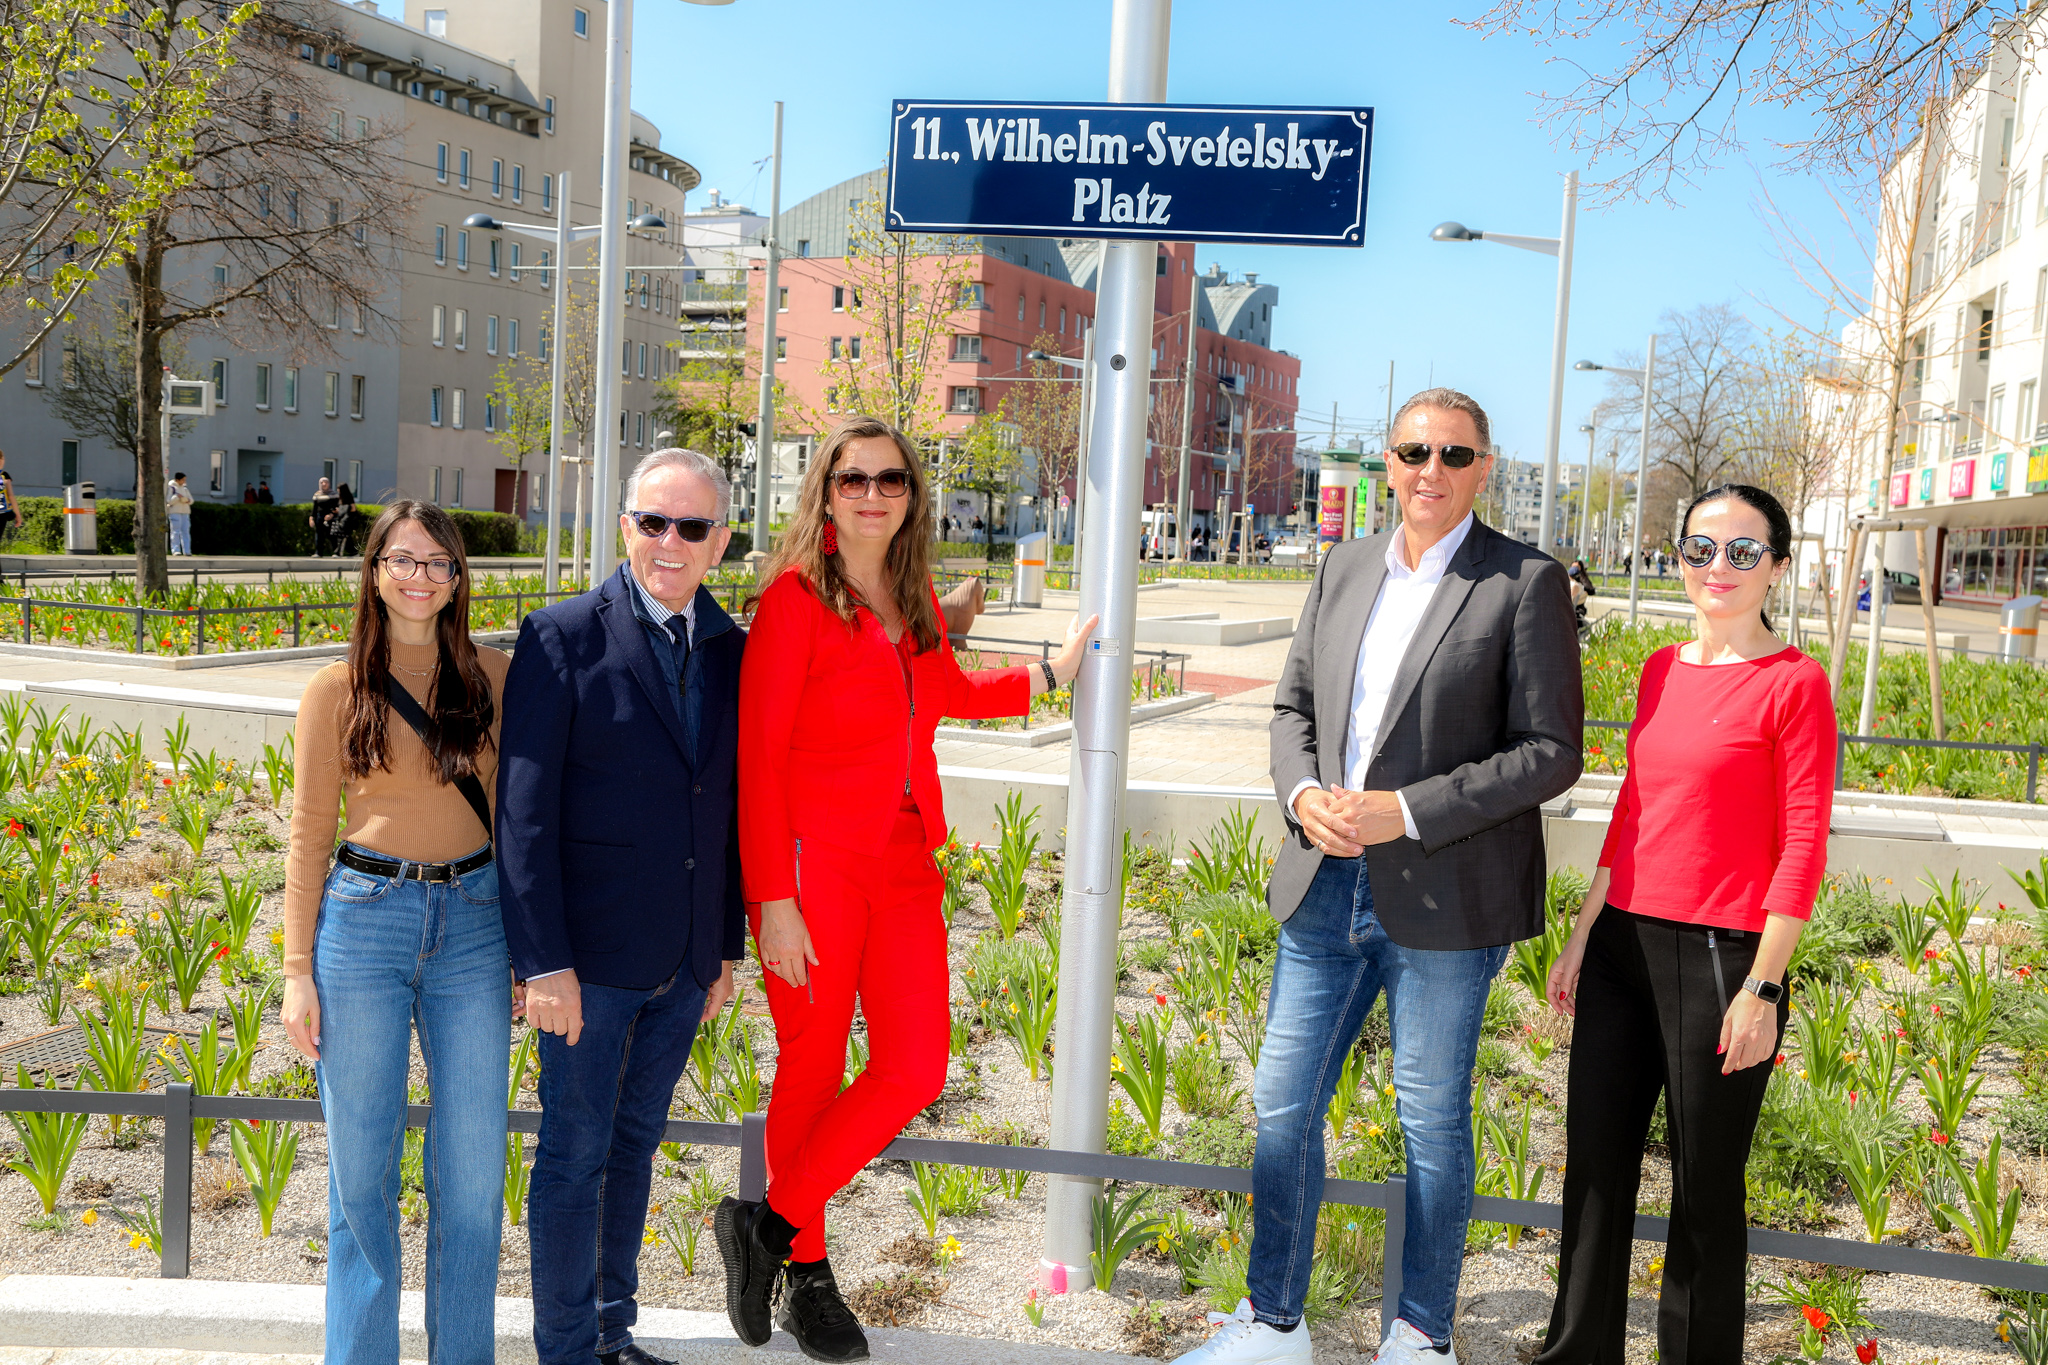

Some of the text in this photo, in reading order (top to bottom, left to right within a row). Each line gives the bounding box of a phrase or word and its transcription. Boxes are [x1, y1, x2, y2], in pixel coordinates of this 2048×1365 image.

[910, 116, 1355, 182] 11., Wilhelm-Svetelsky-
[1071, 177, 1172, 226] Platz
